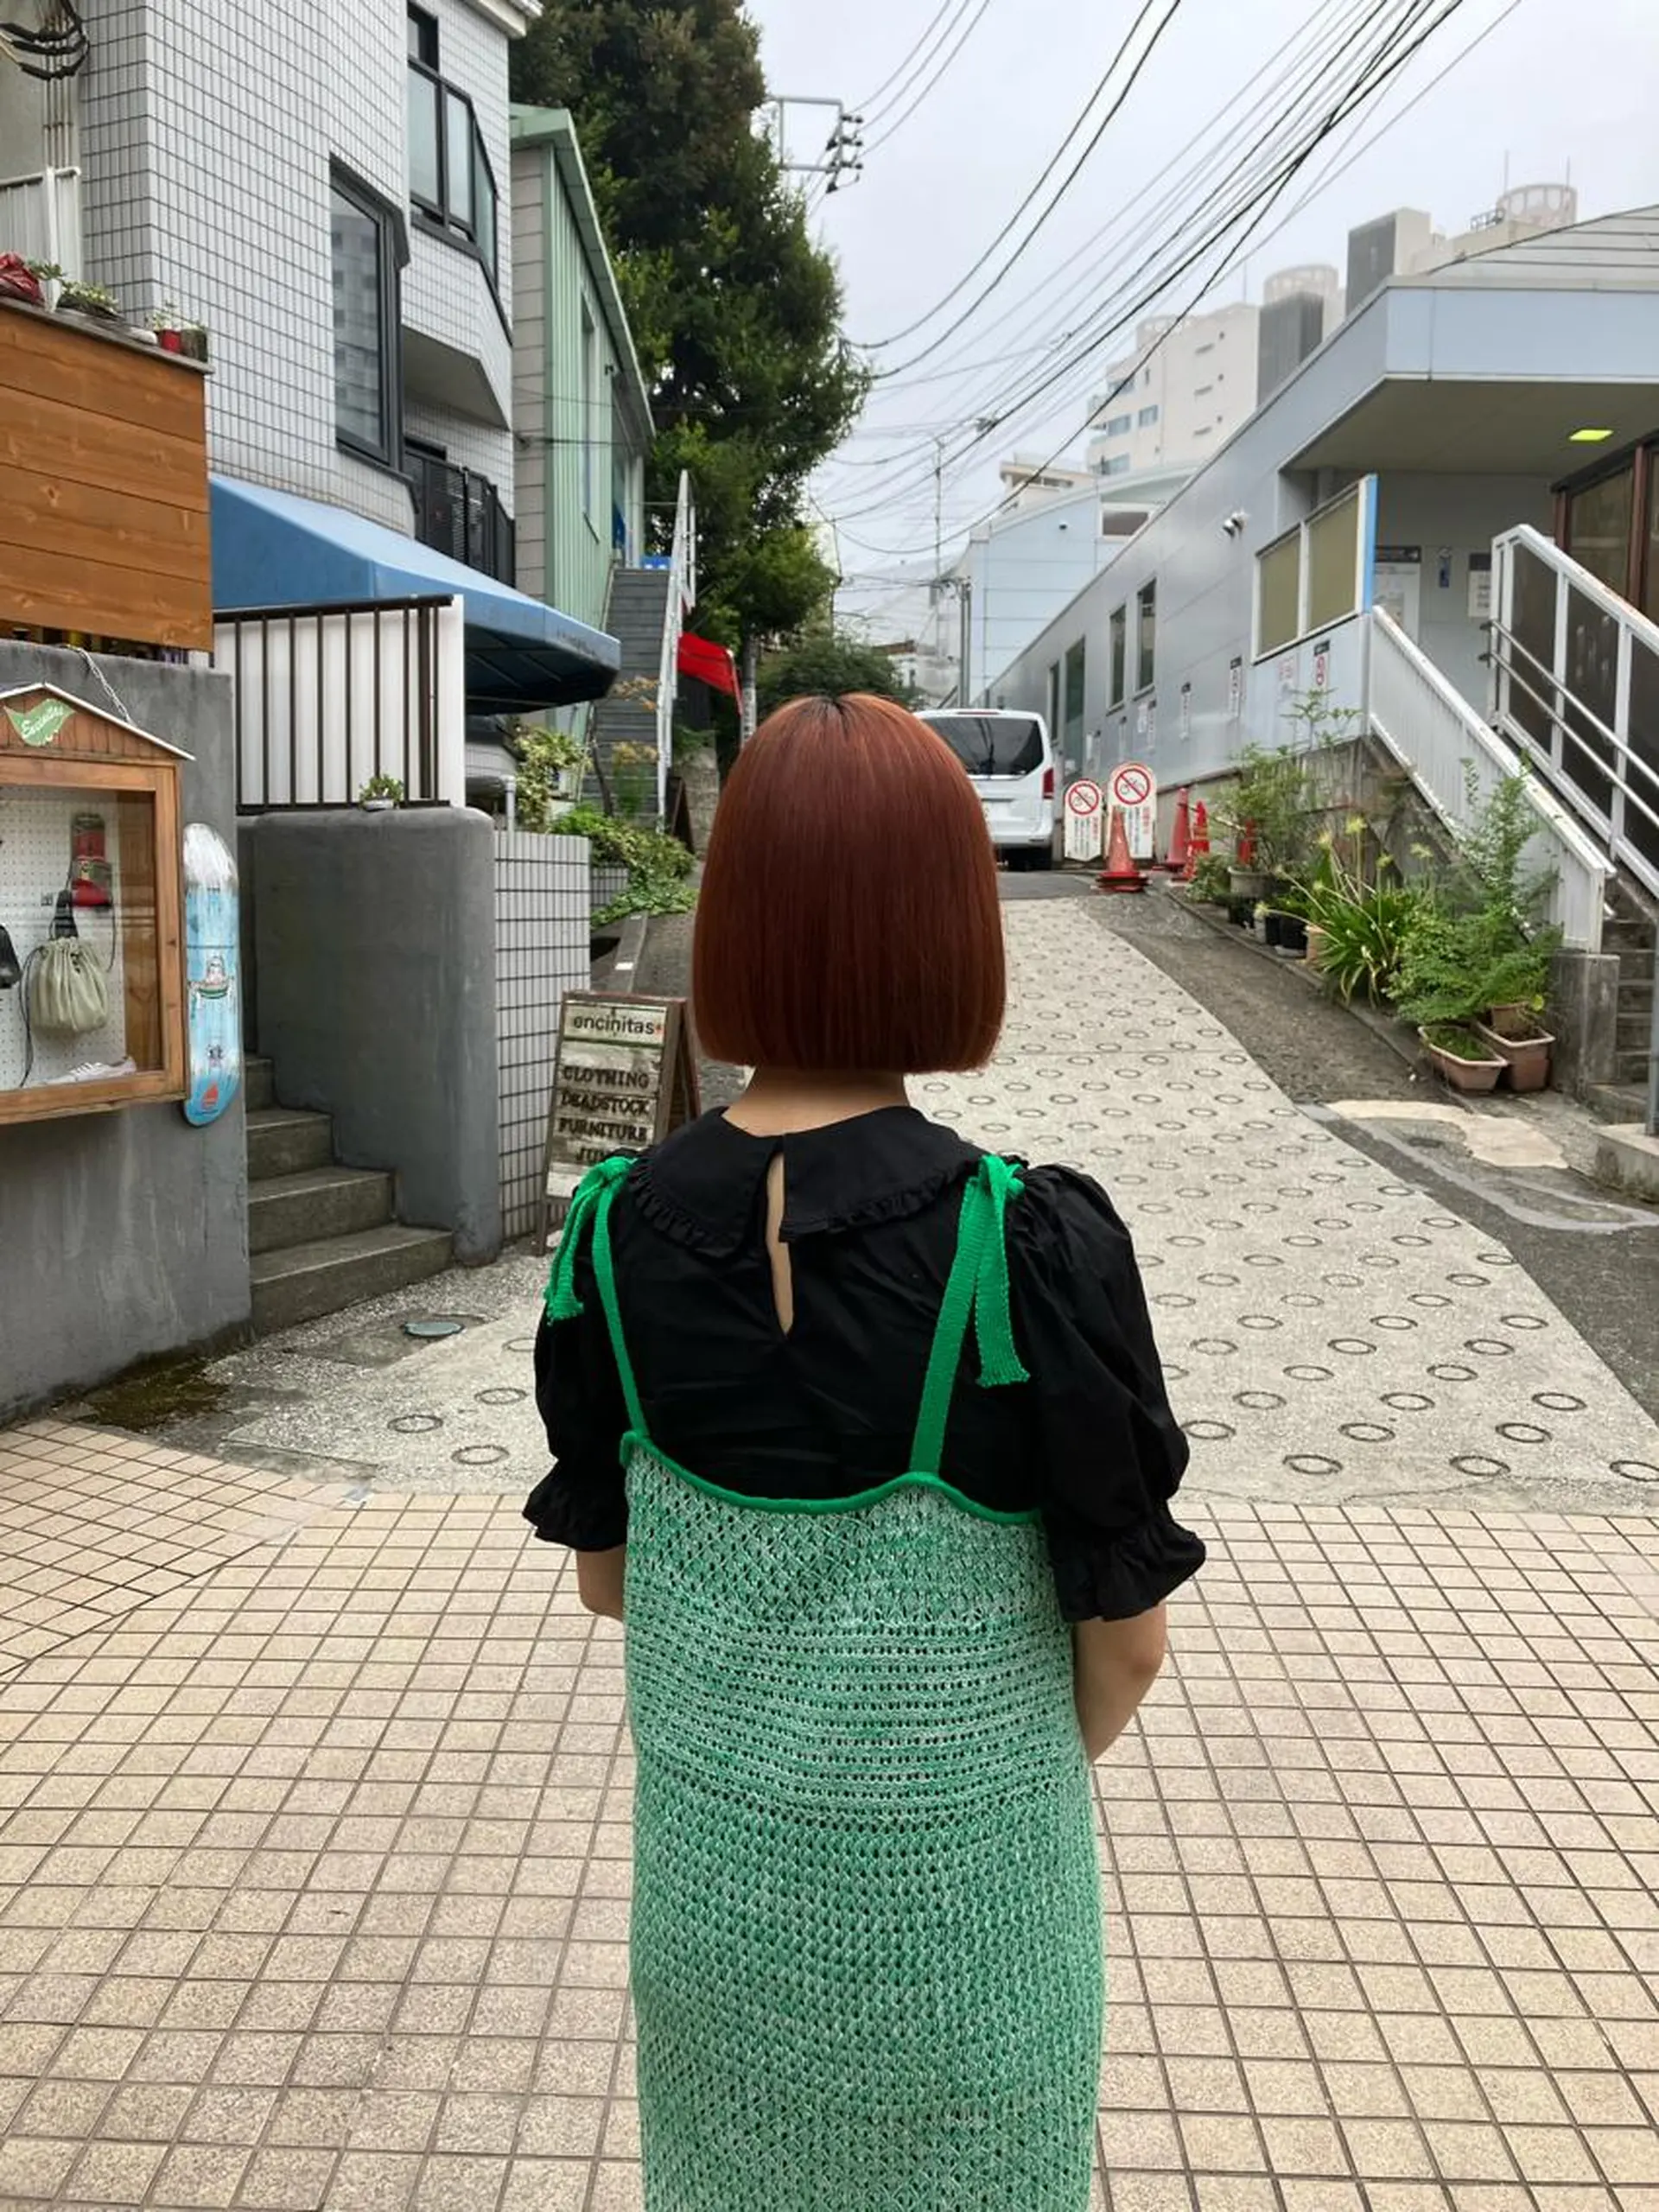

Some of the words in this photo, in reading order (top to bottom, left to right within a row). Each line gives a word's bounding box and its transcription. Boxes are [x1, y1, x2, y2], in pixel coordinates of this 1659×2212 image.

[563, 1065, 649, 1088] CLOTHING
[562, 1091, 649, 1116] DEADSTOCK
[559, 1117, 646, 1141] FURNITURE
